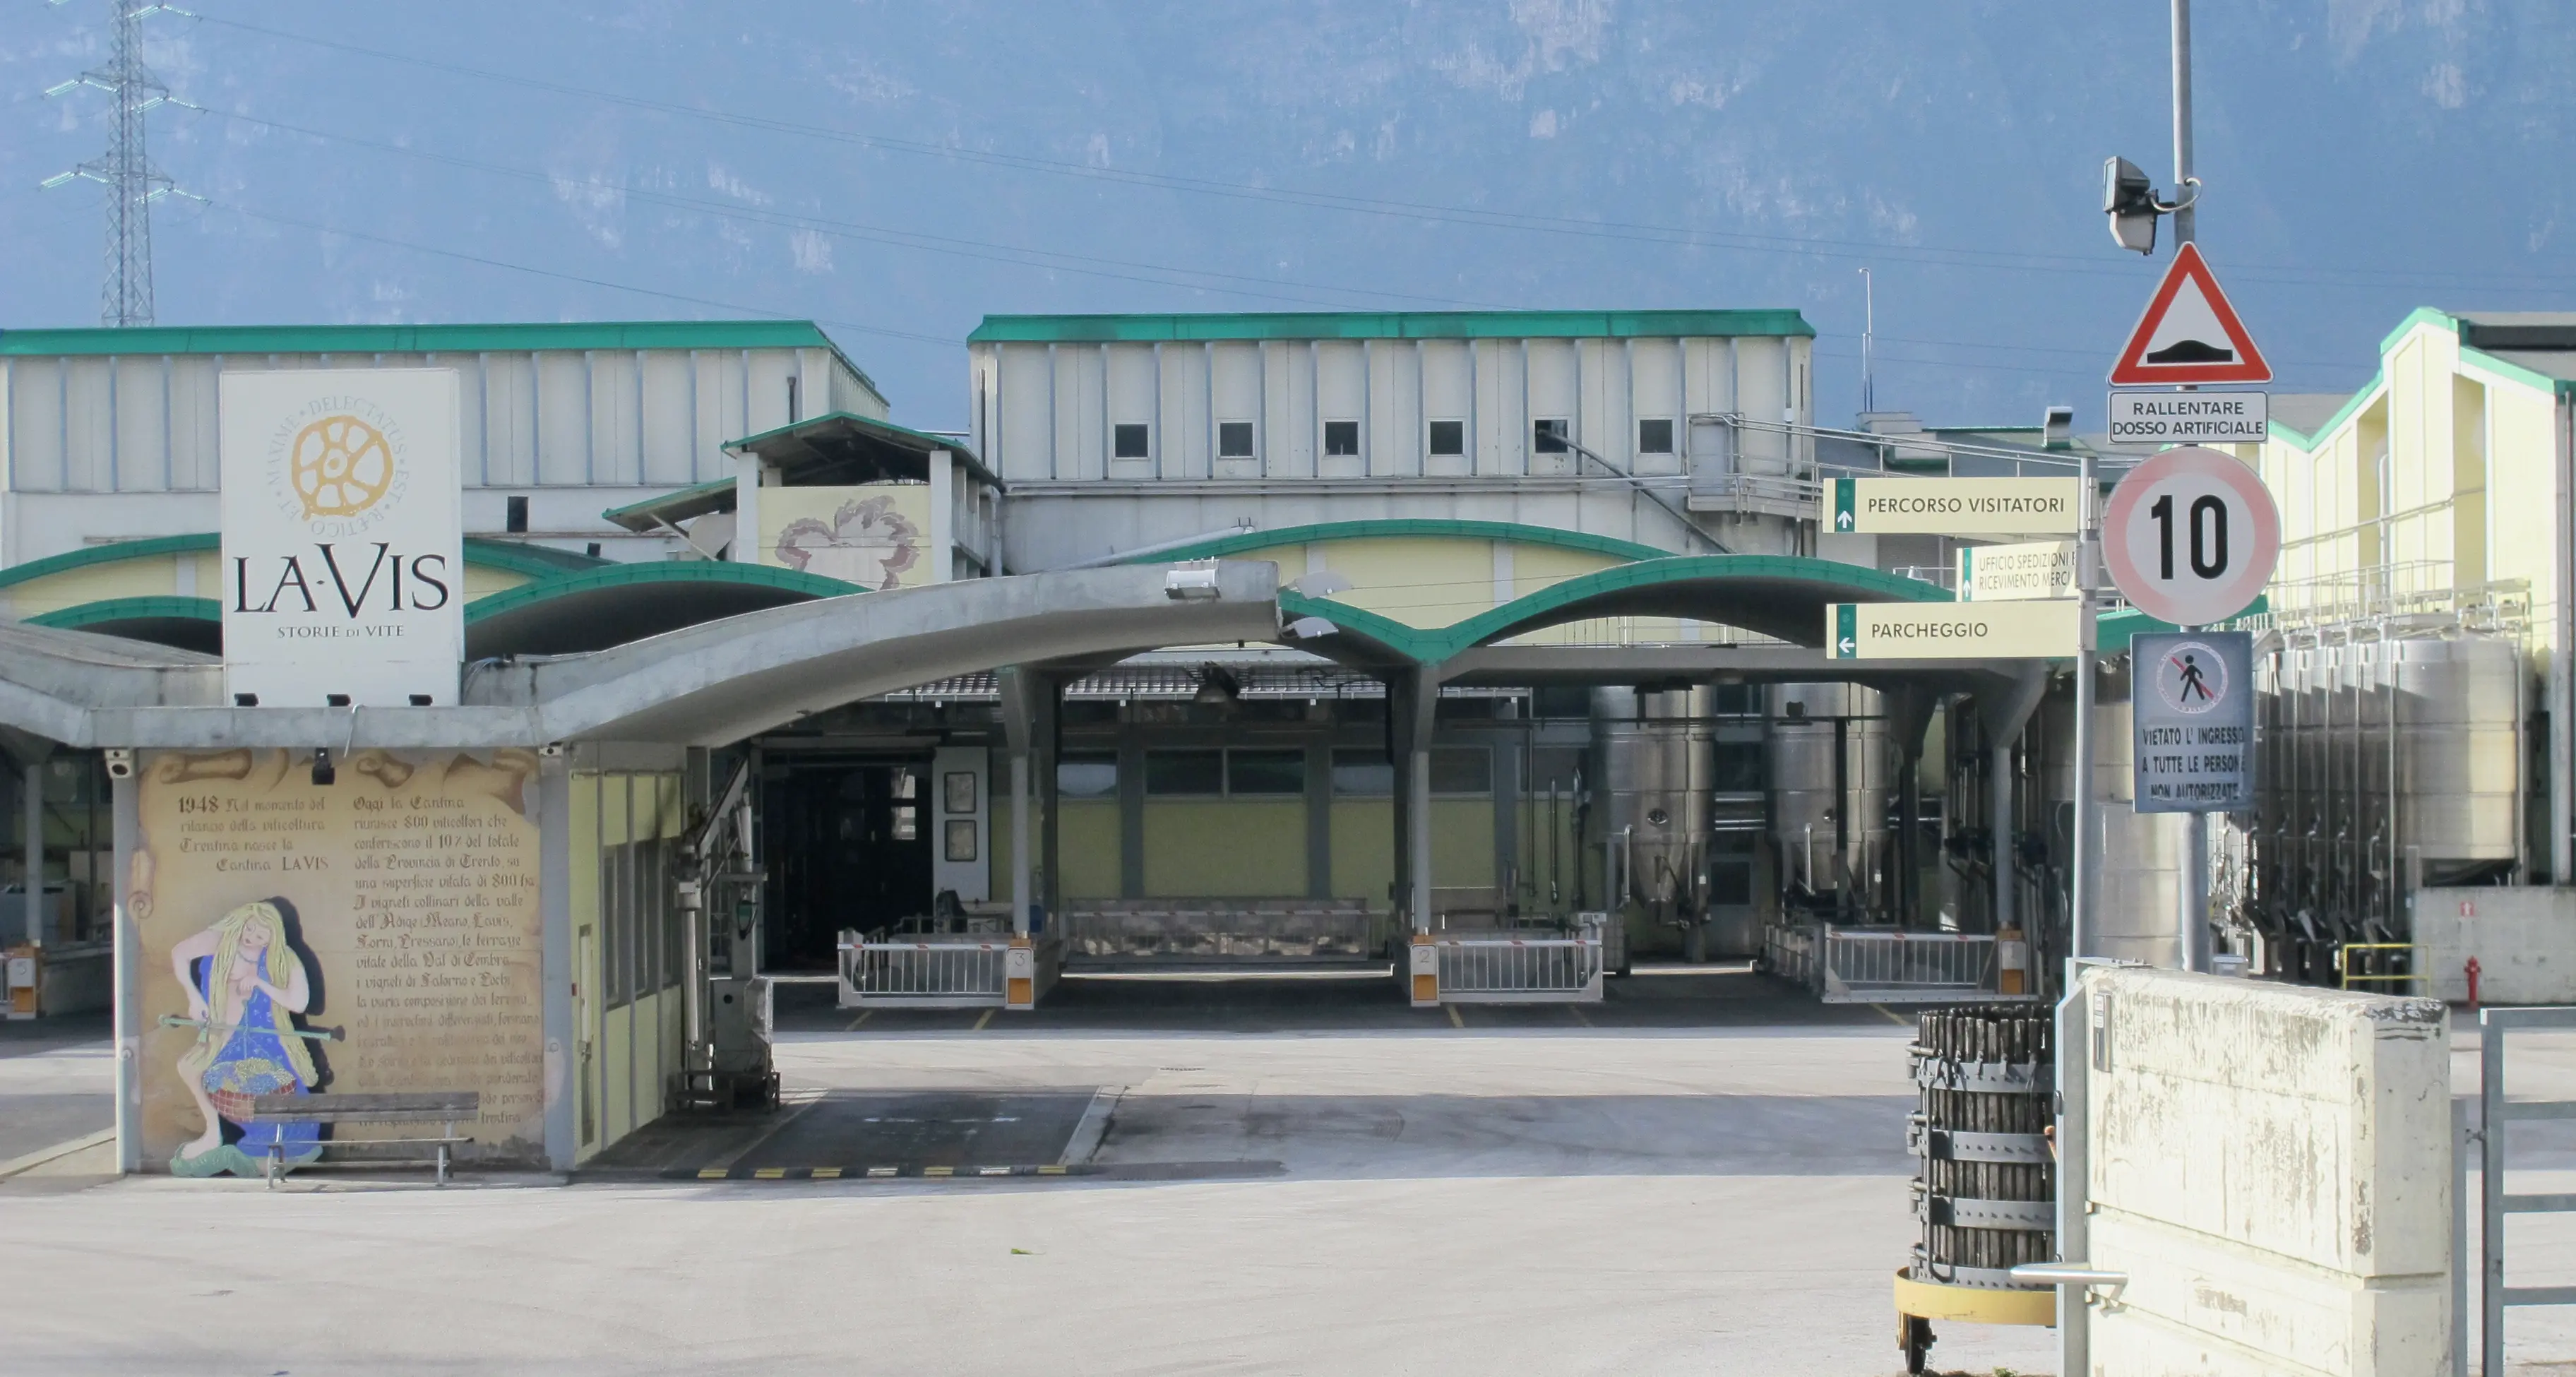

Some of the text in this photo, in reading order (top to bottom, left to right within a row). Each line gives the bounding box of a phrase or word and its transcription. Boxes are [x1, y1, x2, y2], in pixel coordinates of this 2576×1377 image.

[2133, 402, 2244, 416] RALLENTARE
[309, 395, 407, 454] DELECTATUS
[2112, 421, 2263, 435] DOSSO ARTIFICIALE
[266, 414, 300, 486] MAXIME
[388, 470, 410, 503] EST
[278, 499, 301, 520] ET
[1868, 497, 2065, 513] PERCORSO VISITATORI
[2151, 494, 2228, 580] 10
[1979, 556, 2014, 571] UFFICIO
[2017, 552, 2069, 569] SPEDIZIONI
[1979, 571, 2070, 590] RICEVIMENTO MERCI
[277, 626, 340, 638] STORIE
[366, 625, 405, 637] VITE
[1871, 622, 1988, 638] PARCHEGGIO
[2142, 727, 2181, 745] VIETATO
[2198, 727, 2244, 744] INGRESSO
[2142, 757, 2148, 773] A
[2154, 756, 2183, 773] TUTTE
[2188, 756, 2199, 773] LE
[2150, 783, 2238, 801] NON AUTORIZZATE
[178, 795, 220, 813] 1948
[391, 796, 403, 809] la
[404, 815, 428, 829] 800
[487, 814, 507, 828] che
[282, 838, 294, 852] la
[446, 856, 455, 868] di
[477, 875, 487, 888] di
[491, 874, 516, 888] 800
[1015, 952, 1025, 966] 3
[1420, 949, 1429, 963] 2
